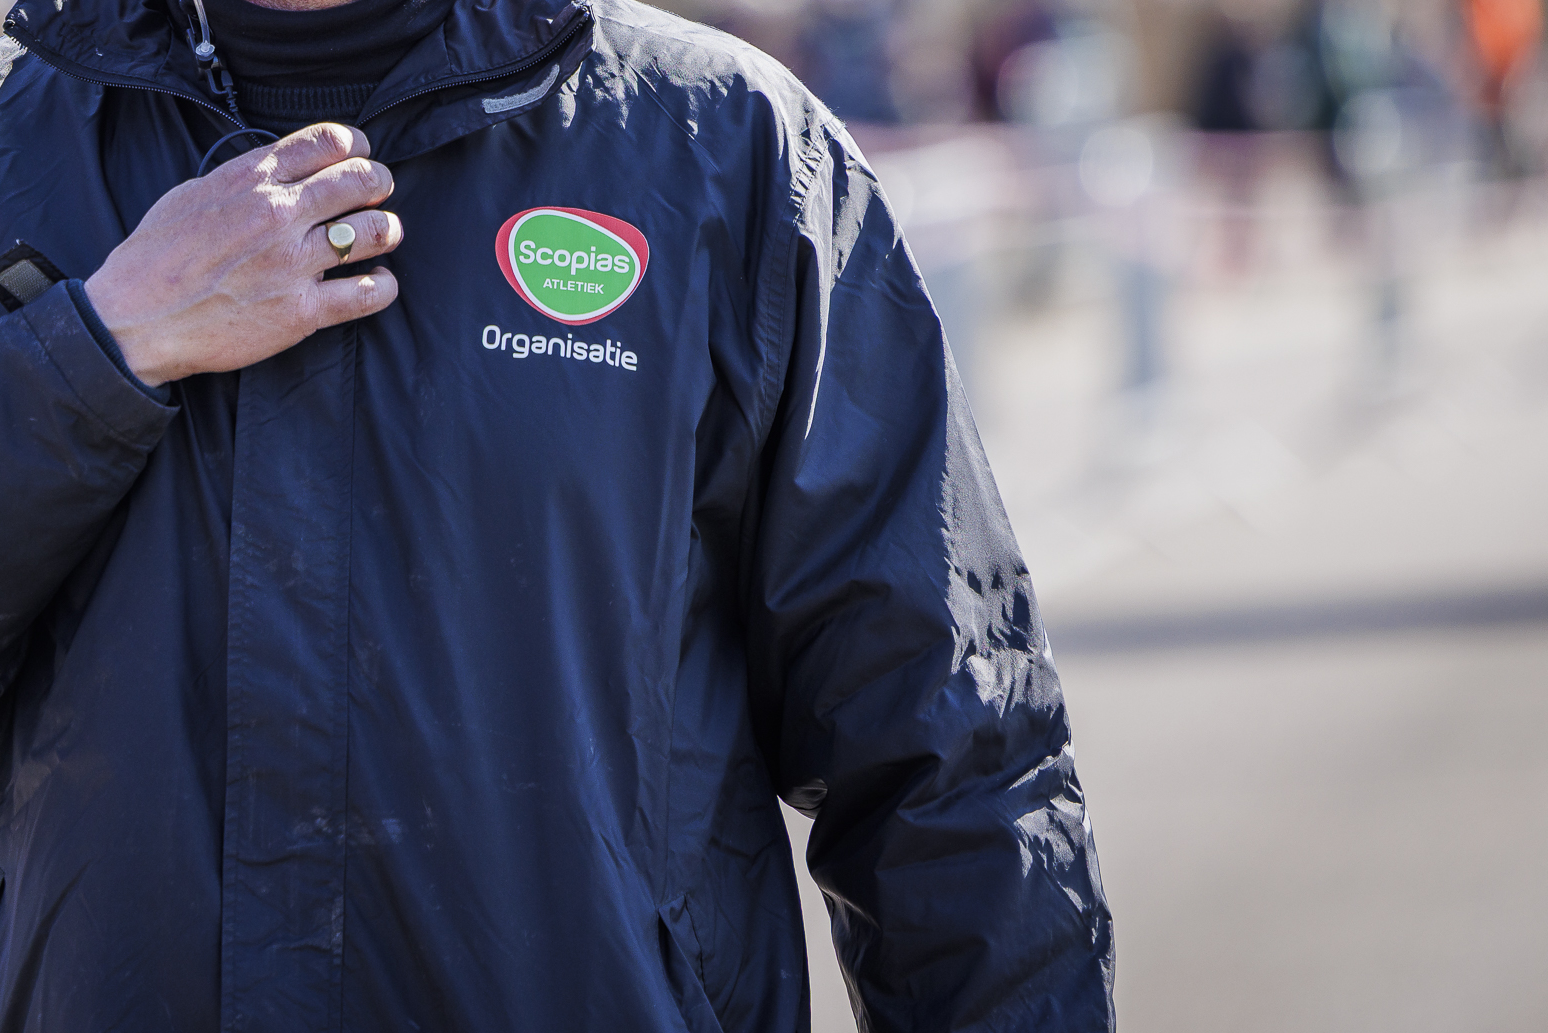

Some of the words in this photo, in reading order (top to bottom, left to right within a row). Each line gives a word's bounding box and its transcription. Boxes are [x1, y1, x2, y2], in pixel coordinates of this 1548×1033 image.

[518, 239, 630, 275] Scopias
[542, 278, 604, 295] ATLETIEK
[482, 324, 638, 371] Organisatie
